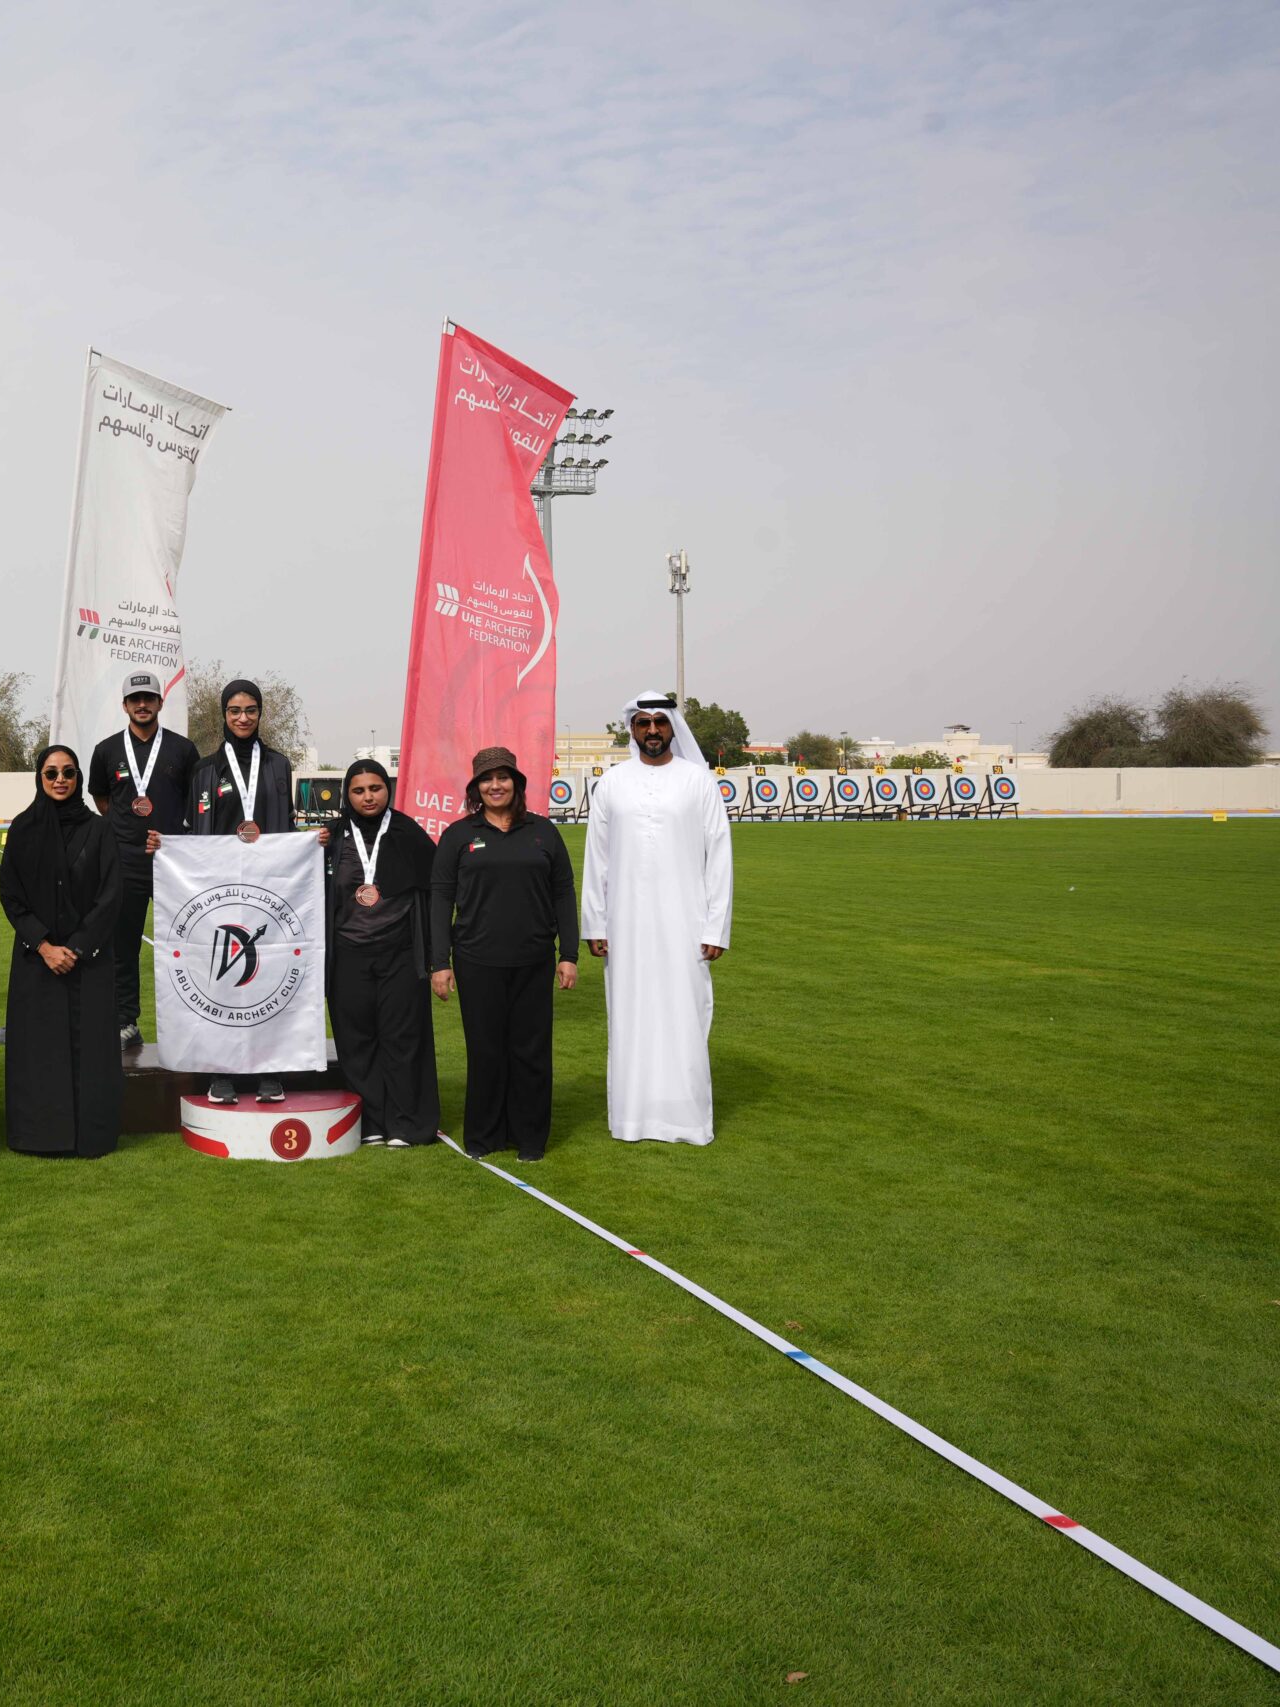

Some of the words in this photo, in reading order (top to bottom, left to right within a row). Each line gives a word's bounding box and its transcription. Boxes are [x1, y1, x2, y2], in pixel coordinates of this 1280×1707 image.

[102, 384, 163, 424] الإمارات
[509, 396, 557, 430] اتحاد
[98, 415, 154, 447] والسهم
[167, 411, 210, 440] اتحاد
[157, 440, 200, 464] للقوس
[466, 596, 499, 613] والسهم
[512, 591, 534, 604] اتحاد
[108, 616, 147, 631] والسهم
[499, 605, 533, 619] للقوس
[461, 611, 482, 626] UAE
[484, 620, 532, 640] ARCHERY
[103, 633, 126, 647] UAE
[128, 638, 180, 655] ARCHERY
[469, 628, 531, 654] FEDERATION
[110, 648, 178, 668] FEDERATION
[415, 790, 454, 812] UAE
[175, 968, 191, 992] ABU
[189, 993, 223, 1018] DHABI
[227, 997, 279, 1021] ARCHERY
[280, 967, 300, 998] CLUB
[283, 1128, 298, 1150] 3
